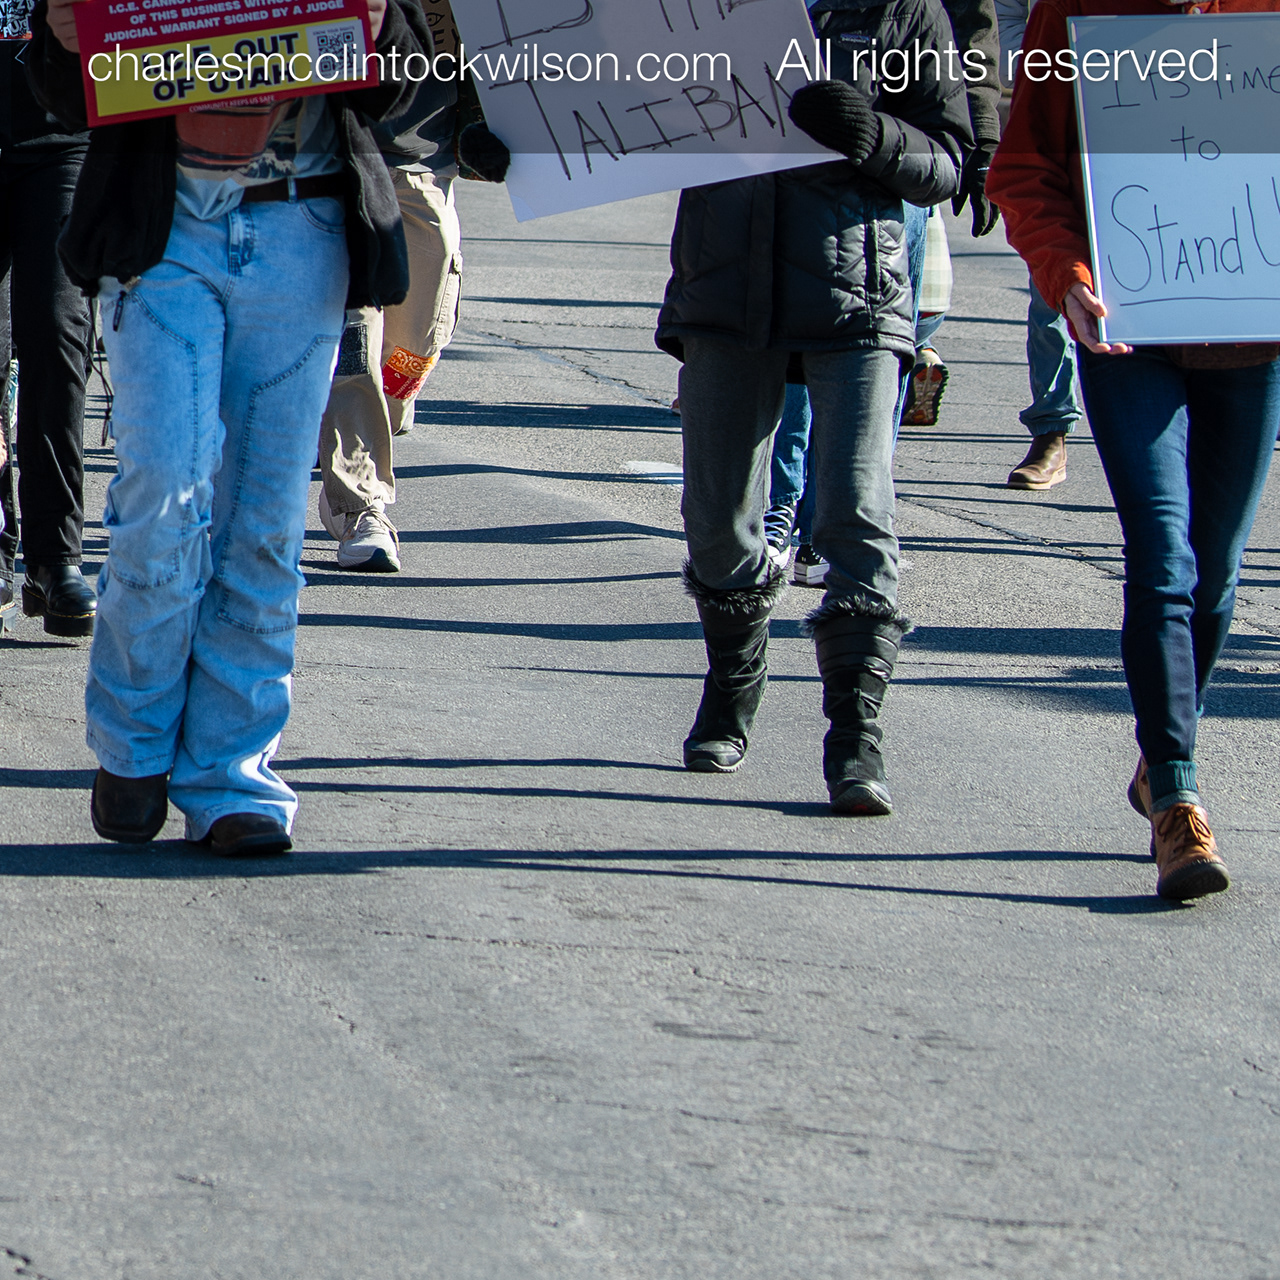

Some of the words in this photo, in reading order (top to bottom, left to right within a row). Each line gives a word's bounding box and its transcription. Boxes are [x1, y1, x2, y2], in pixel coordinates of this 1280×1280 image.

[103, 27, 157, 43] JUDICIAL
[160, 17, 220, 35] WARRANT
[224, 10, 269, 26] SIGNED
[271, 6, 288, 18] BY
[292, 5, 303, 15] A
[305, 0, 344, 13] JUDGE
[109, 2, 140, 15] I.C.E.
[129, 14, 147, 25] OF
[149, 8, 178, 23] THIS
[181, 0, 241, 17] BUSINESS
[234, 33, 299, 62] OUT
[153, 78, 195, 102] OF
[208, 62, 296, 95] UTAH
[249, 97, 259, 106] US
[260, 94, 275, 105] SAFE
[1171, 125, 1221, 162] to
